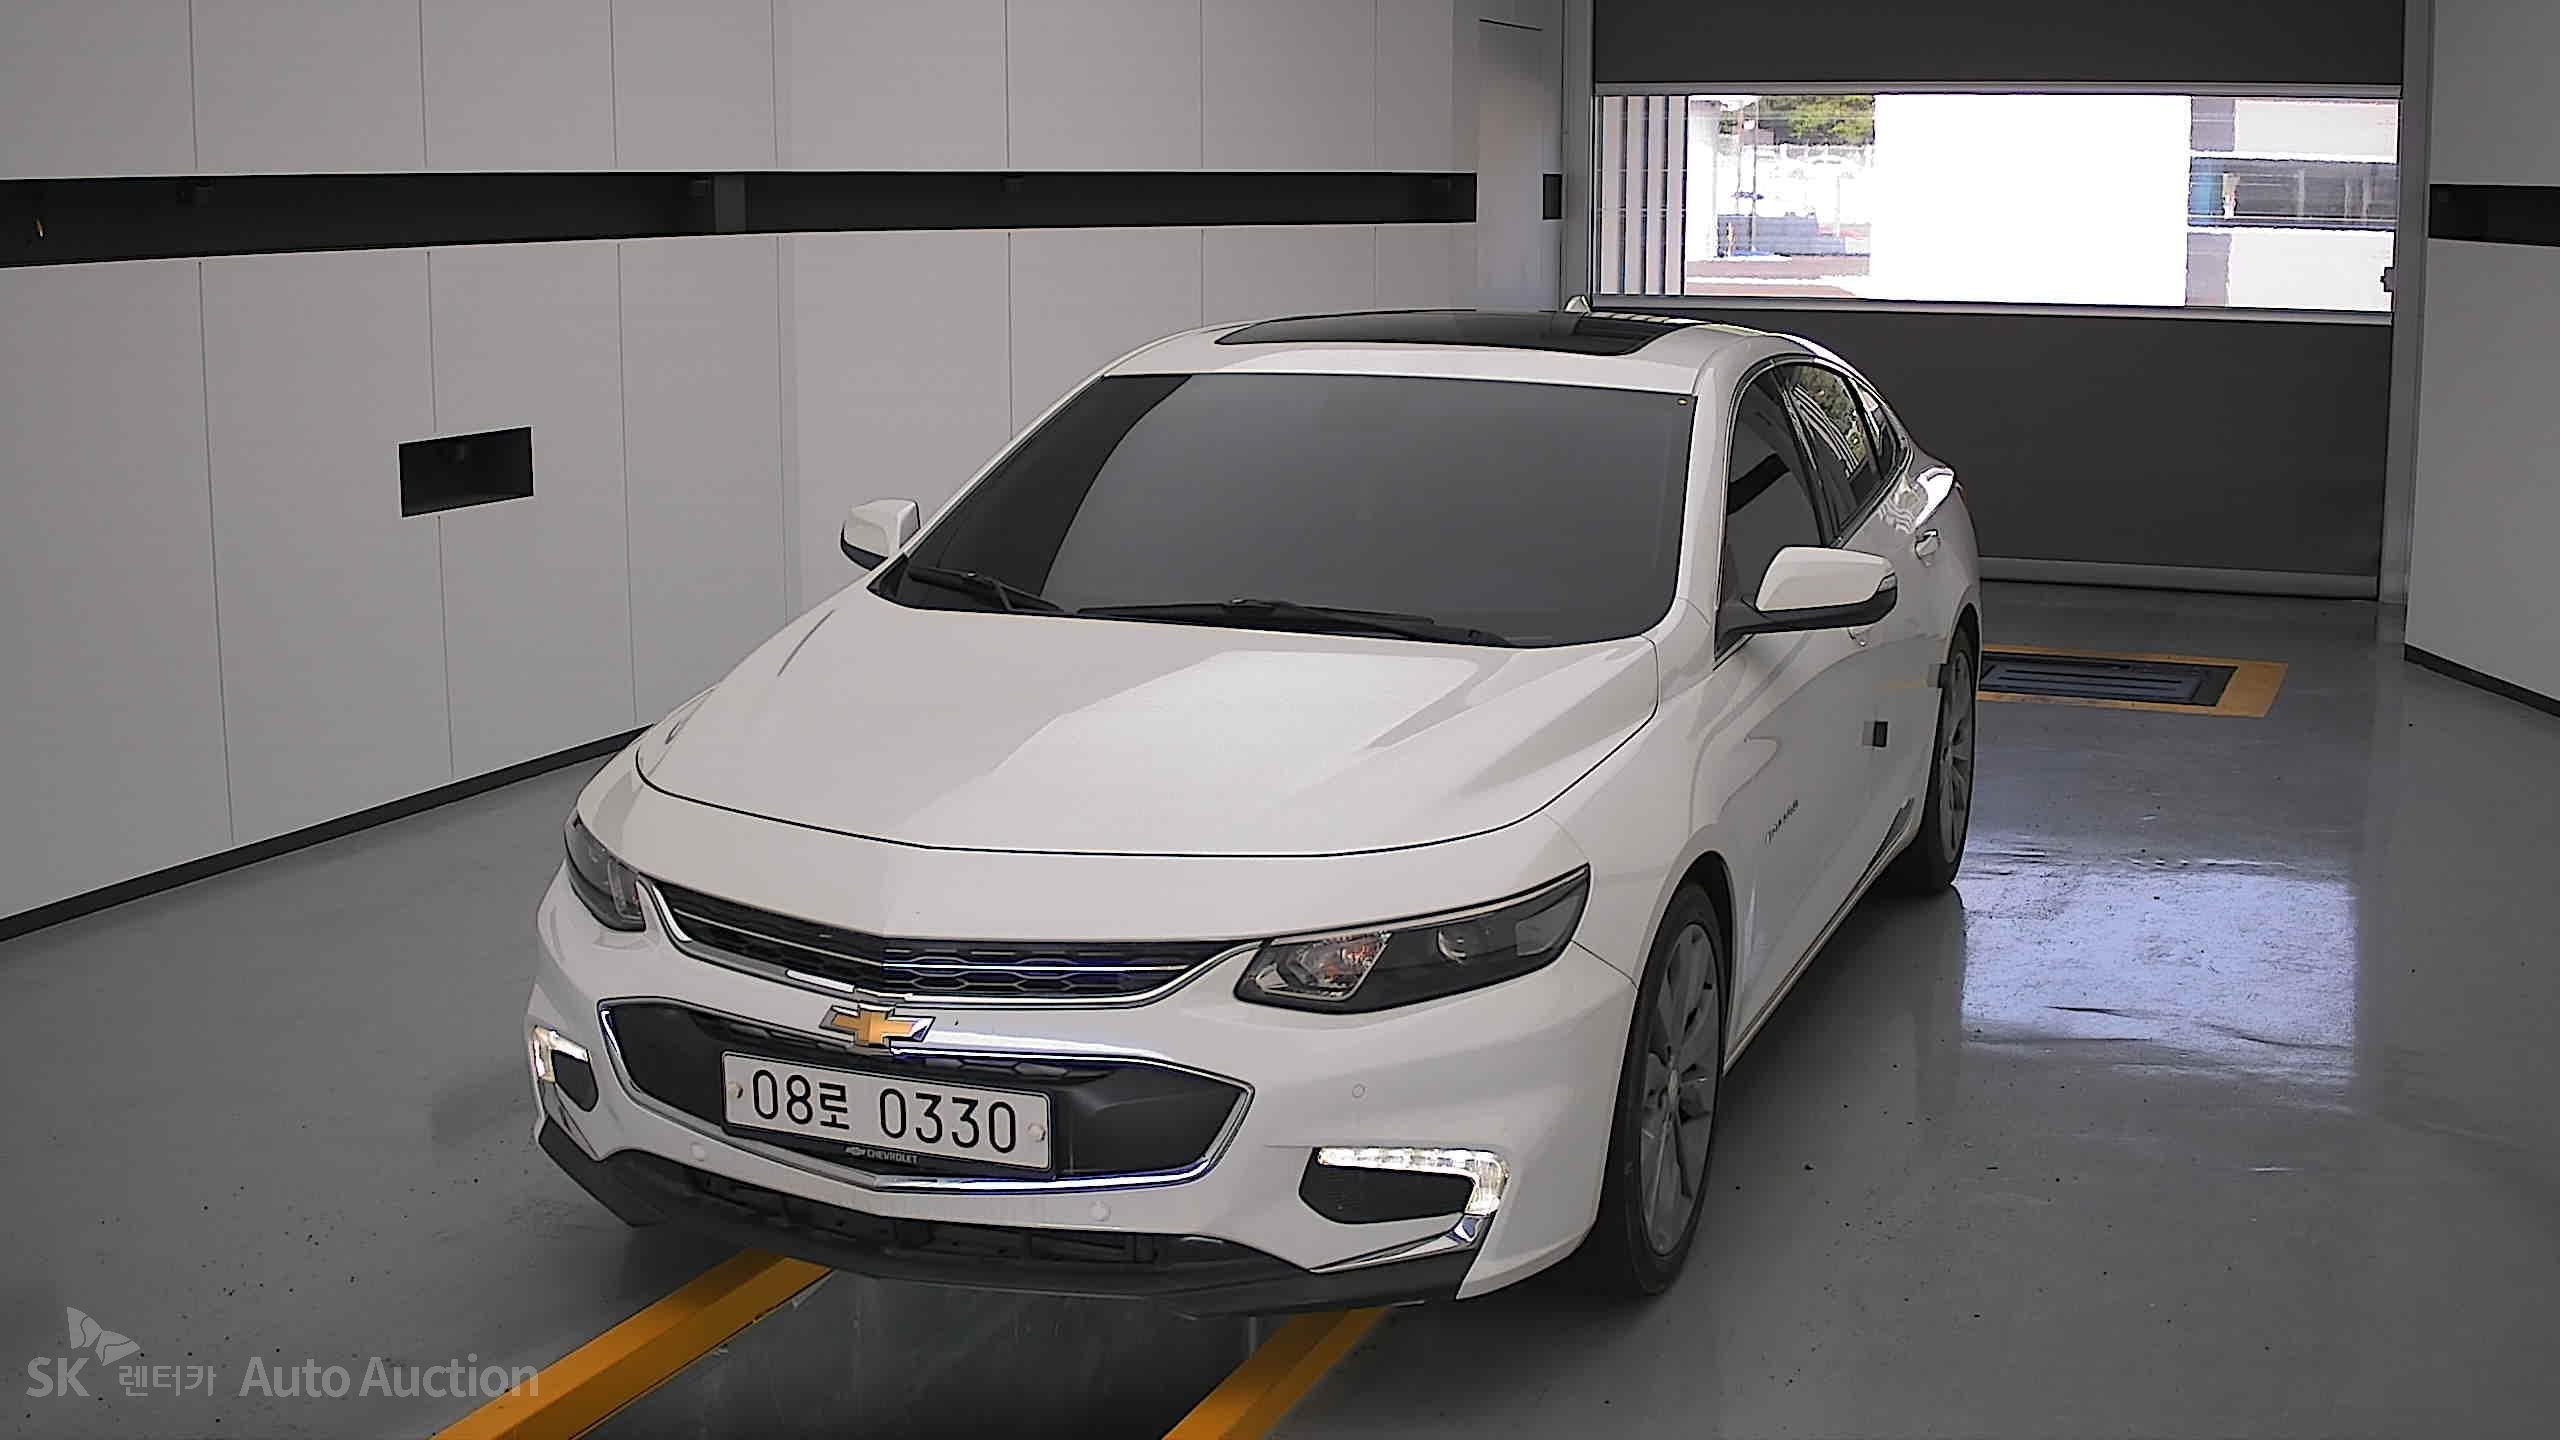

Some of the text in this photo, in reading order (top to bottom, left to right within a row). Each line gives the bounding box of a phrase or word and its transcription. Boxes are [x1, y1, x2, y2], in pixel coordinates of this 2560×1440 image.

[752, 1069, 1016, 1153] 08로 0330
[866, 1149, 919, 1164] CHEVROLET
